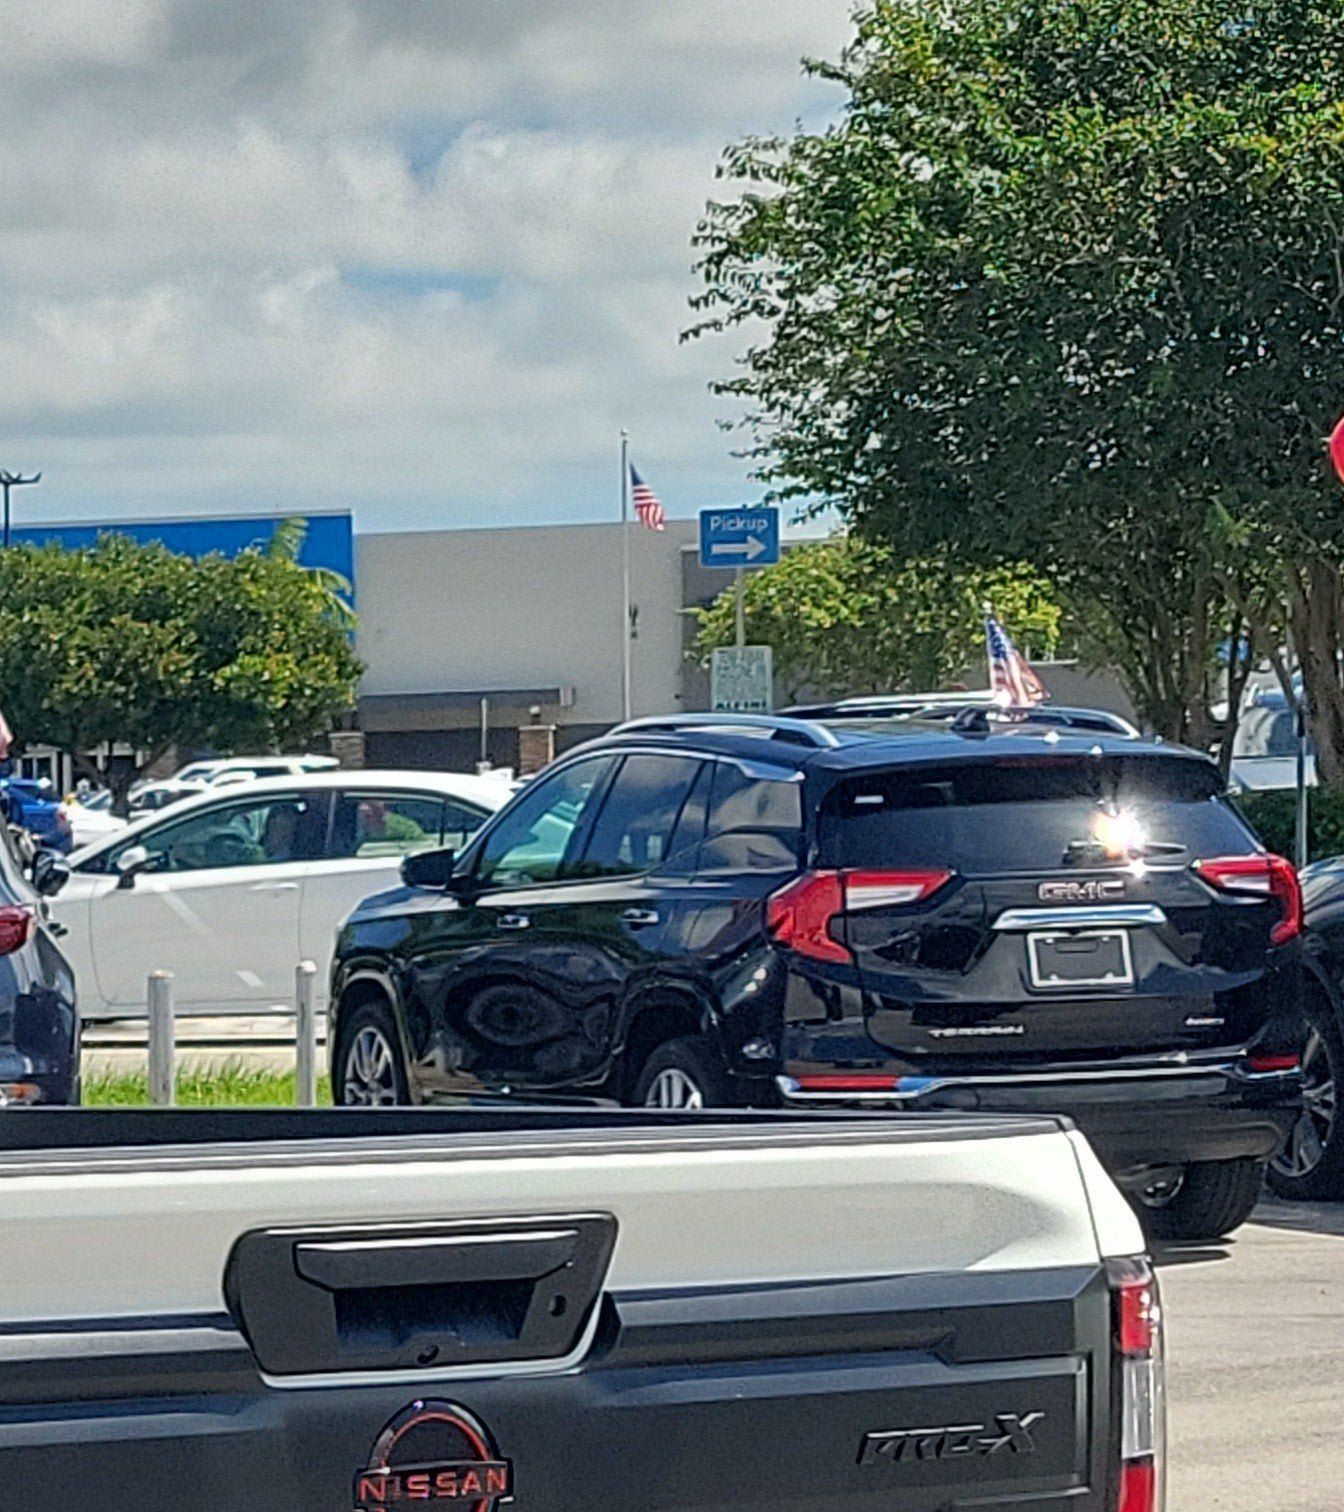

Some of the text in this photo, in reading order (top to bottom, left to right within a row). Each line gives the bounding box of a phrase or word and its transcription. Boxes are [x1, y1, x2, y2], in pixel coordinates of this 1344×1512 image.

[710, 515, 769, 534] Pickup
[1039, 880, 1125, 900] GMC
[358, 1466, 508, 1502] NISSAN
